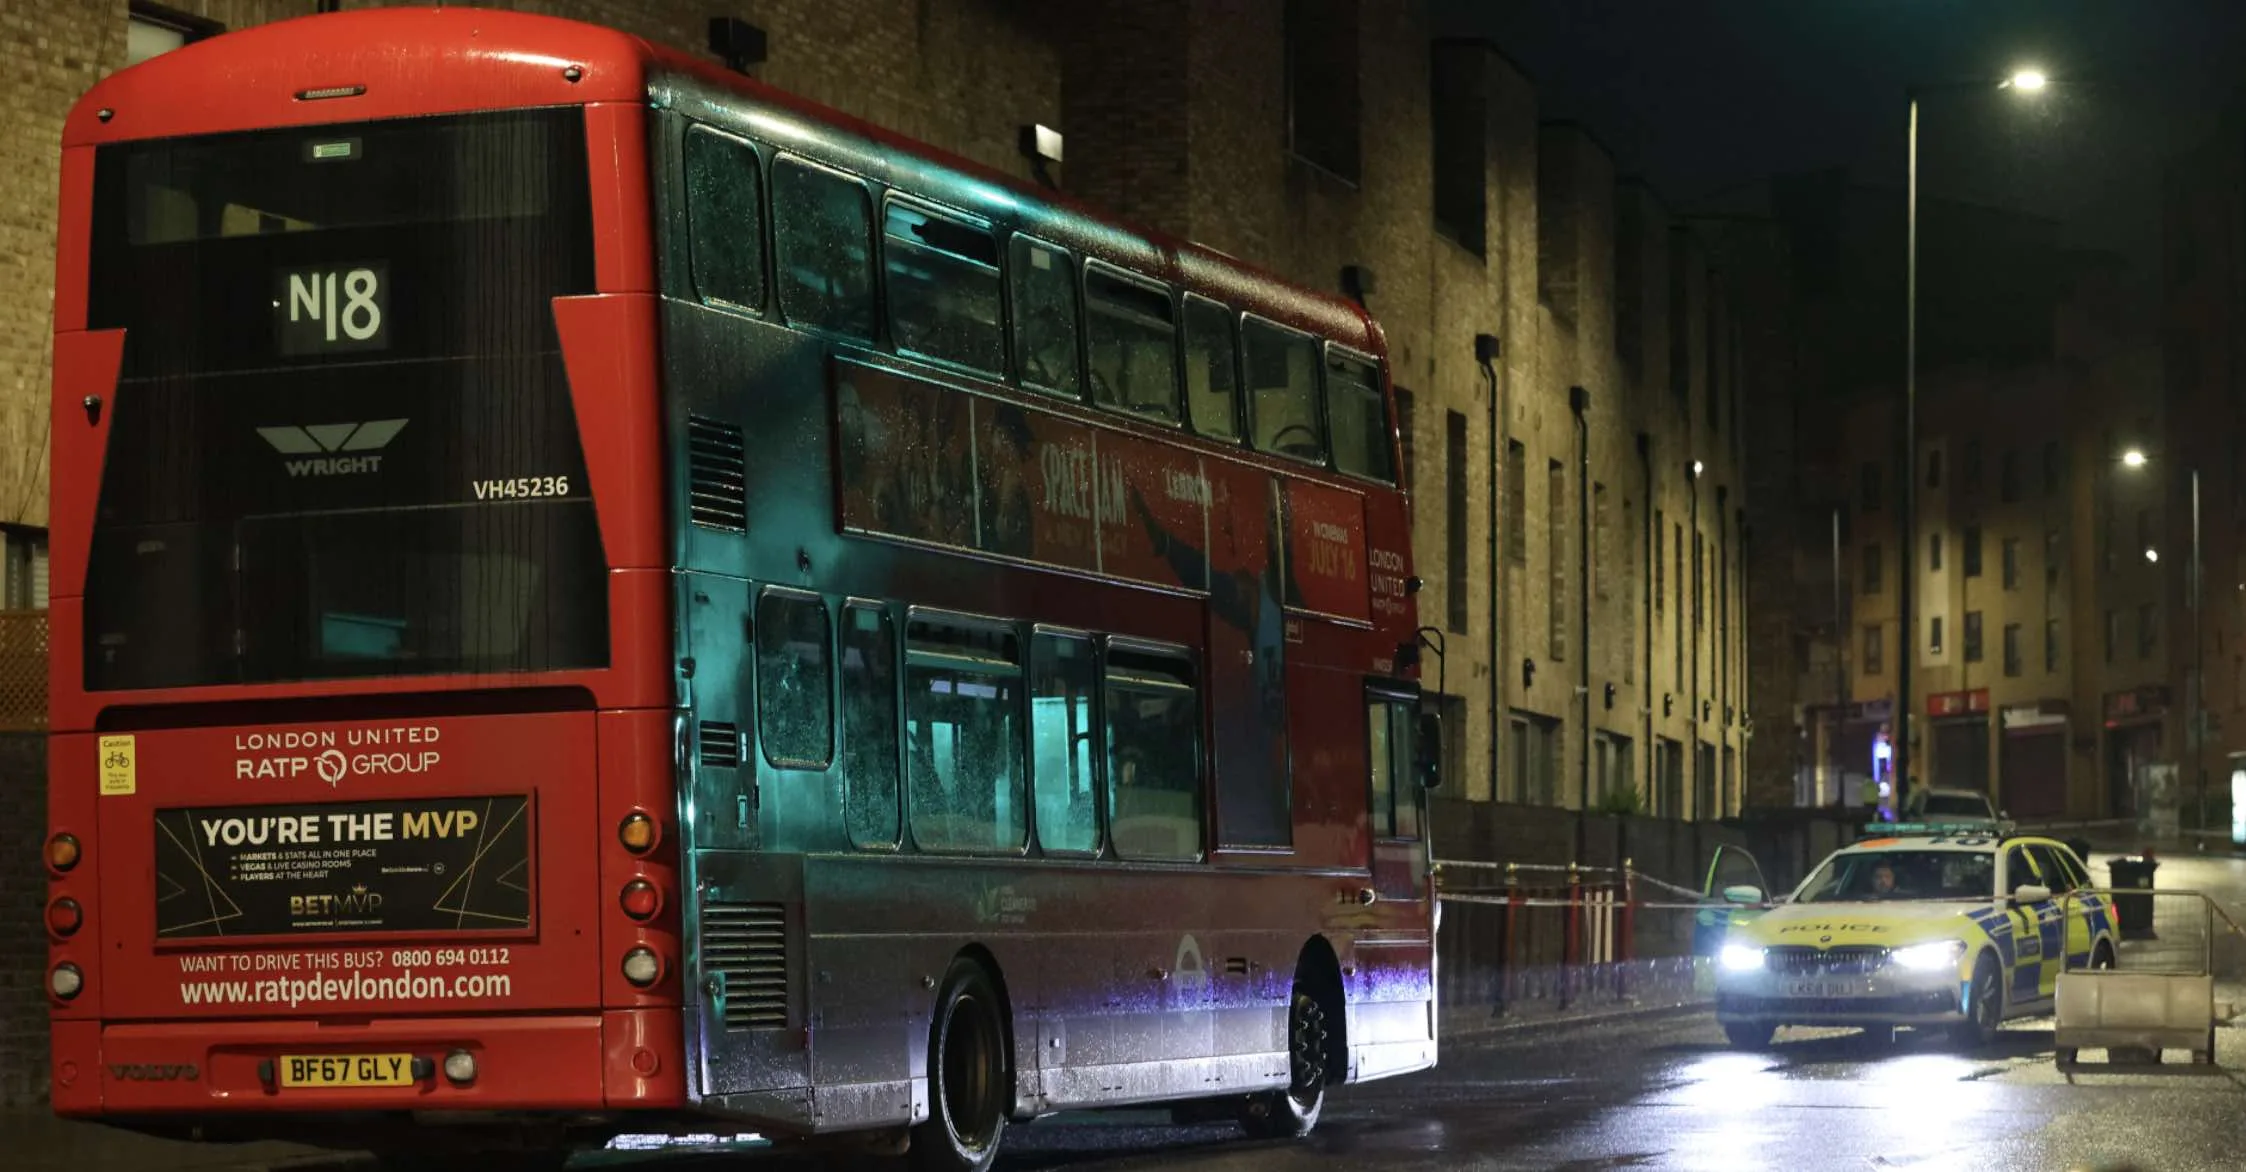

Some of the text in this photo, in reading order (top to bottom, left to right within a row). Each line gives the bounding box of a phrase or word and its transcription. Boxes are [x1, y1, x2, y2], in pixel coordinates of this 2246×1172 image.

[290, 268, 381, 341] N18
[286, 456, 382, 477] WRIGHT
[473, 476, 569, 500] VH45236
[1041, 443, 1090, 519] SPACE
[1369, 547, 1404, 572] LONDON
[1370, 573, 1405, 597] UNITED
[235, 726, 440, 750] LONDON UNITED
[236, 752, 440, 779] RATP GROUP
[201, 810, 478, 846] YOU'RE THE MVP
[240, 852, 277, 861] MARKETS
[285, 851, 307, 859] STATS
[308, 850, 321, 858] ALL
[323, 850, 331, 858] IN
[333, 849, 350, 858] ONE
[352, 848, 377, 857] PLACE
[240, 862, 266, 871] VEGAS
[274, 861, 290, 870] LIVE
[291, 861, 320, 869] CASINO
[322, 860, 352, 868] ROOMS
[240, 870, 329, 881] PLAYERS AT THE HEART
[290, 893, 382, 915] BETMVP
[1781, 923, 1889, 933] POLICE
[180, 948, 510, 972] WANT TO DRIVE THIS BUS? 0800 694 0112
[181, 969, 511, 1008] www.ratpdevlondon.com
[108, 1063, 198, 1082] VOLVO
[290, 1057, 402, 1082] BF67 GLY
